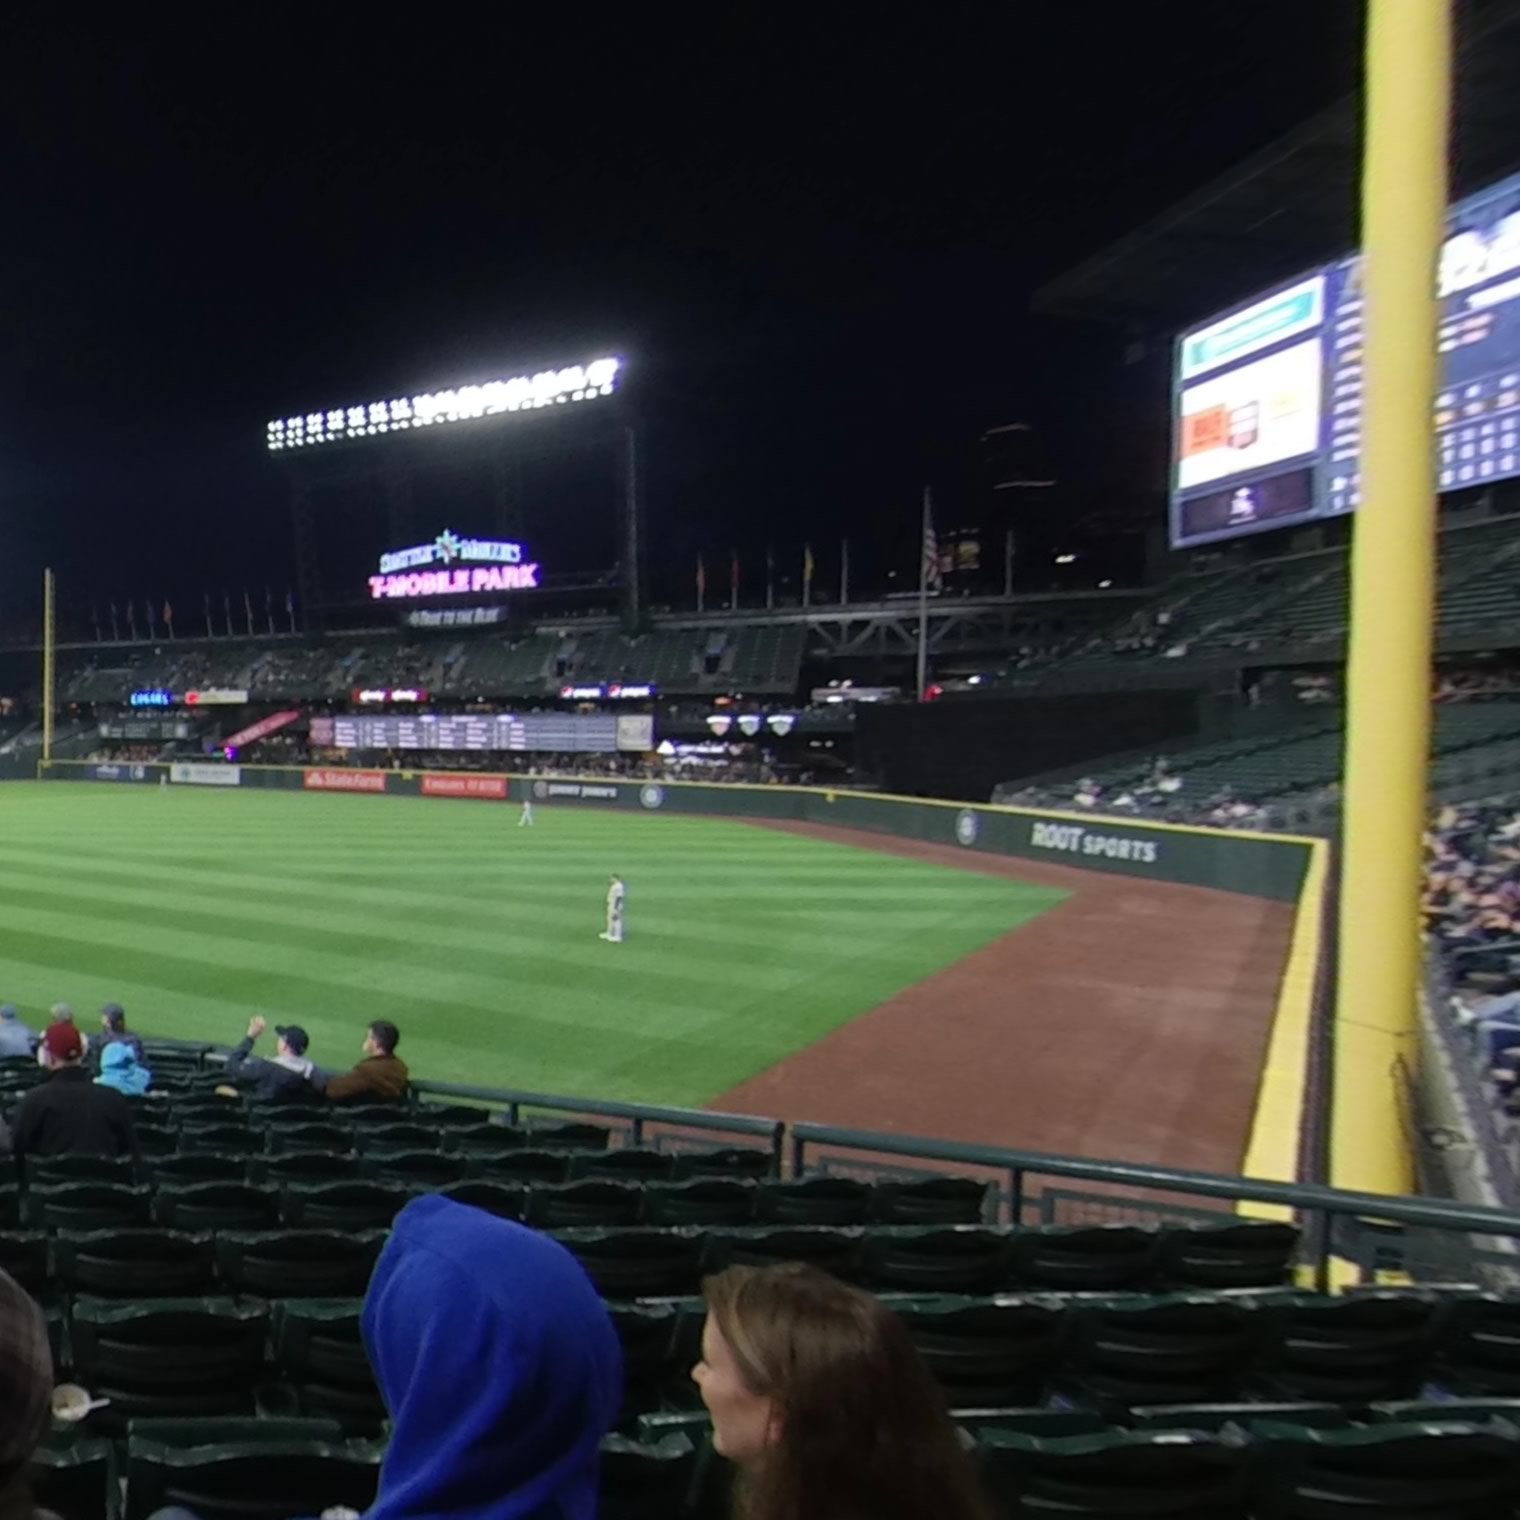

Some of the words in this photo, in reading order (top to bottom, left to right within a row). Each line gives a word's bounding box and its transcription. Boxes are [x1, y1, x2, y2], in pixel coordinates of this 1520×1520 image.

[369, 569, 470, 598] T-MOBILE
[472, 563, 538, 591] PARK
[1032, 822, 1085, 852] ROOT
[1083, 834, 1157, 863] SPORTS
